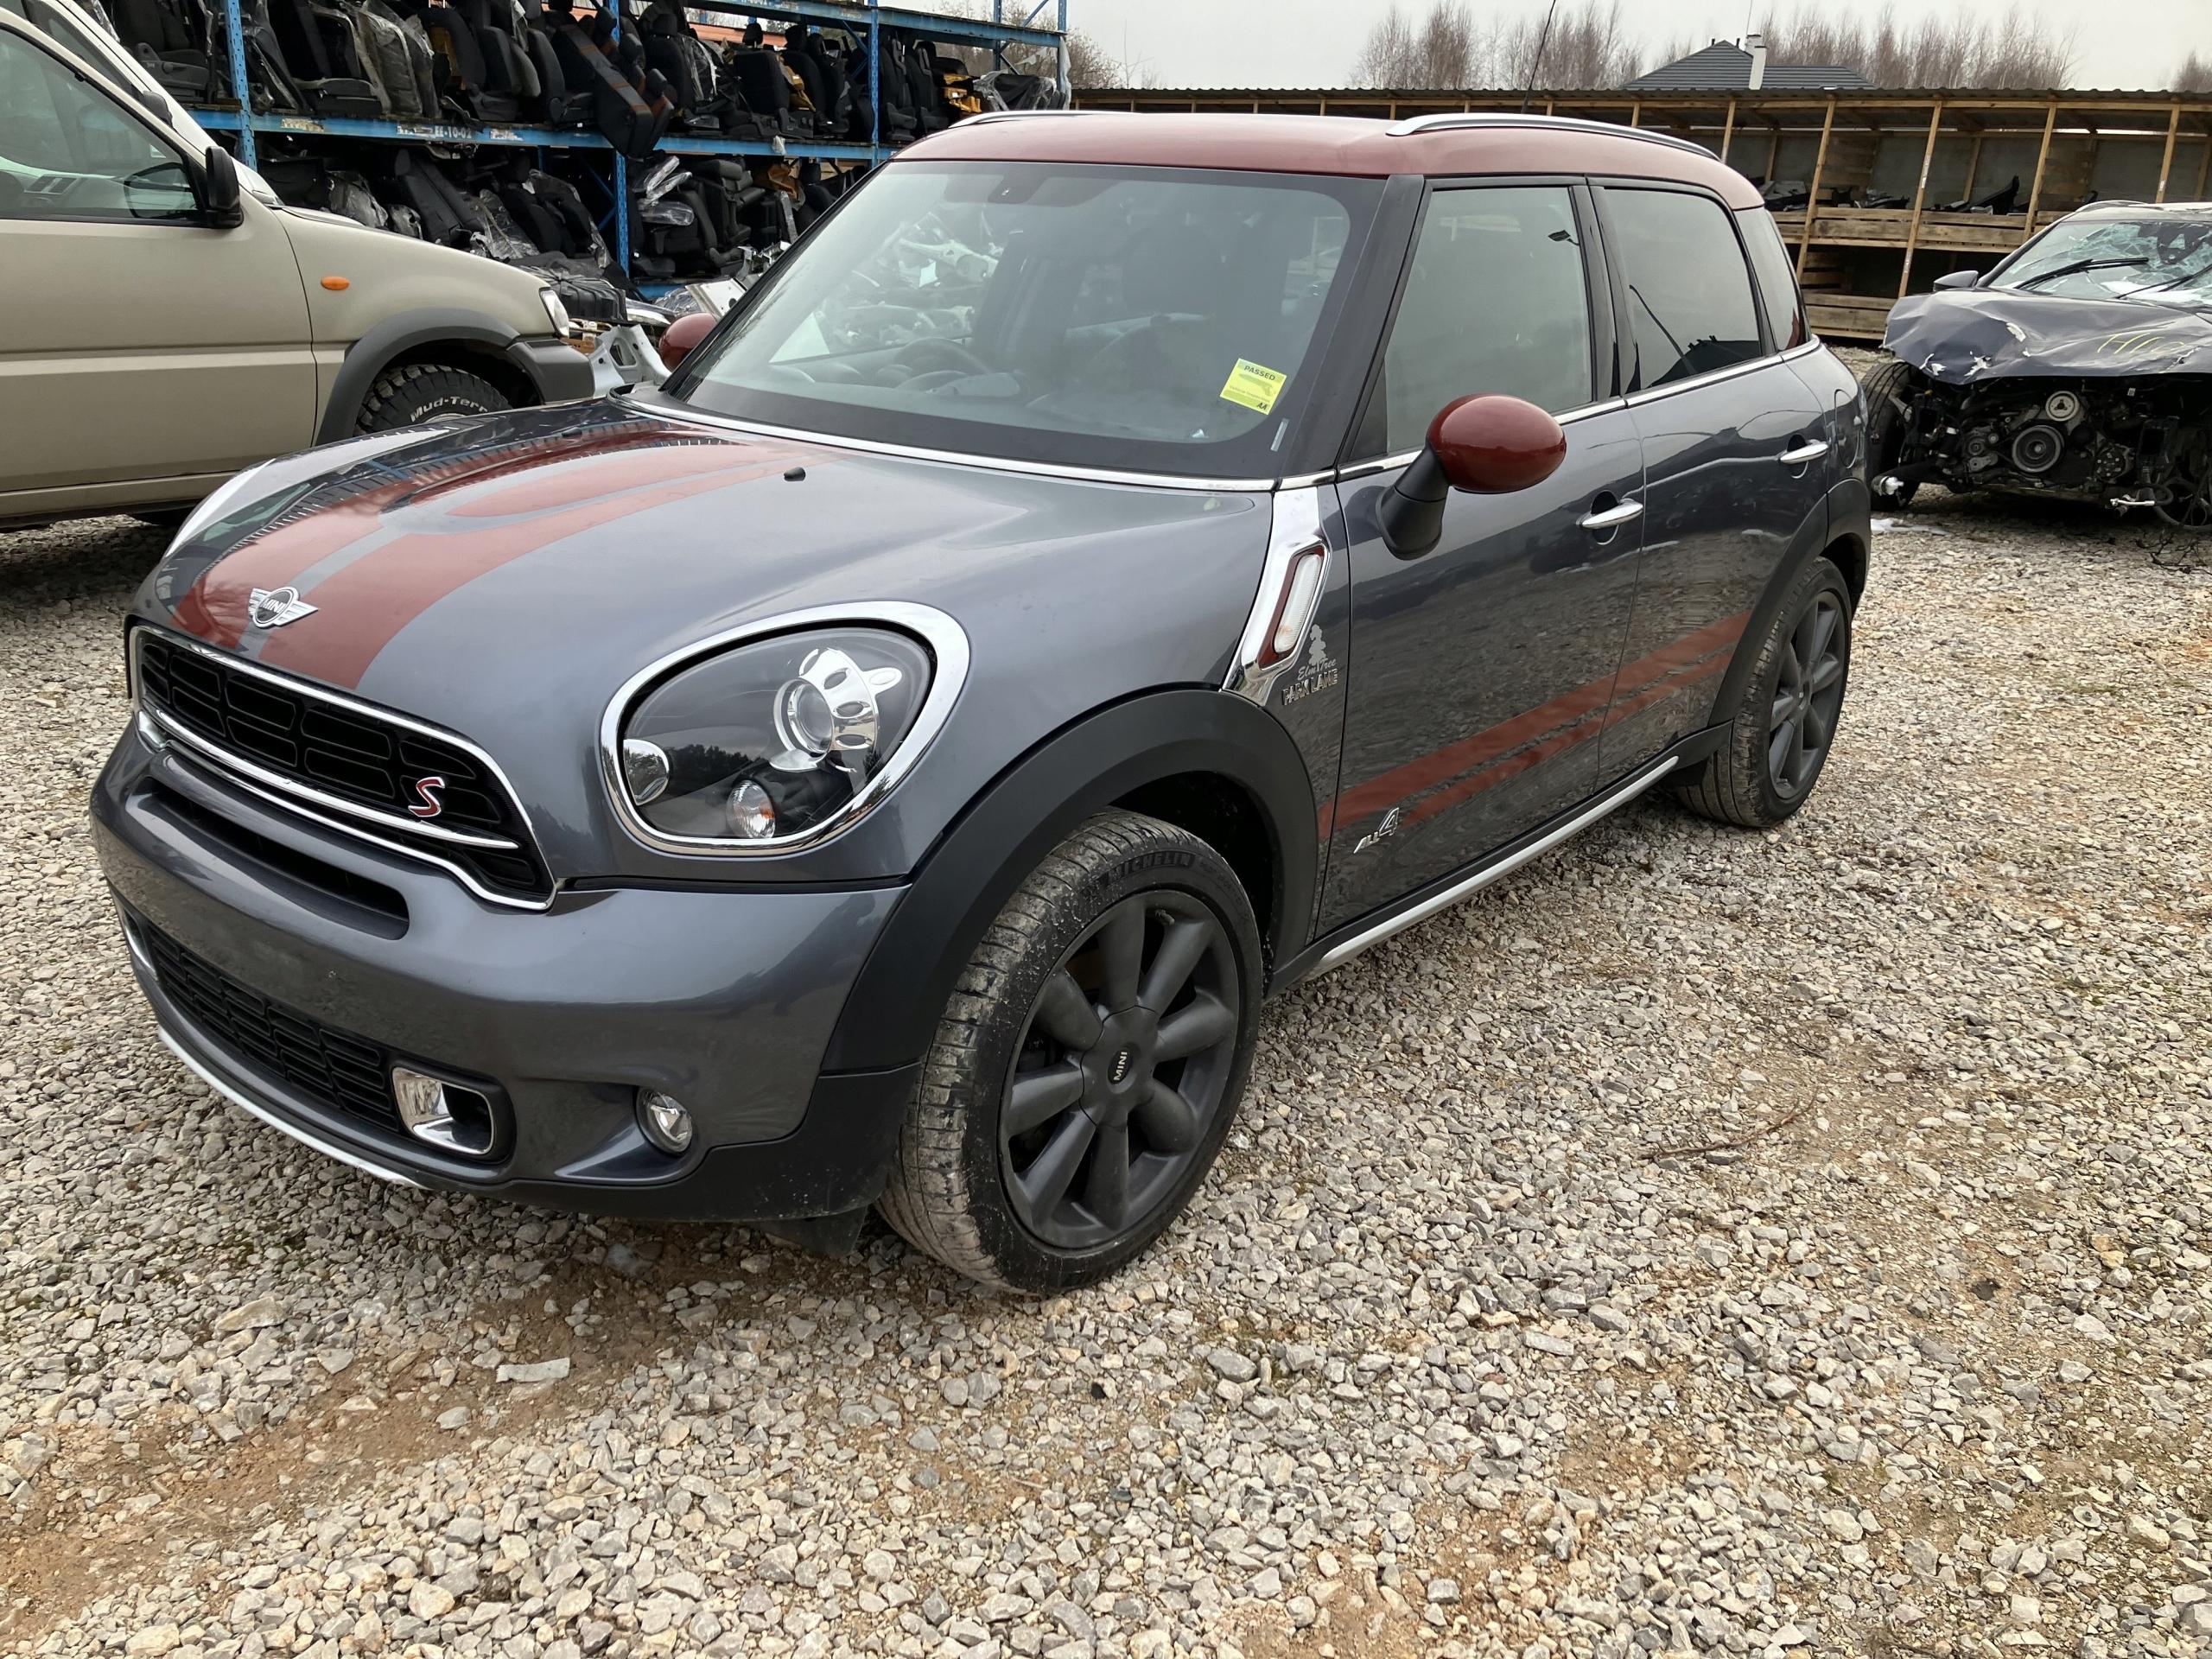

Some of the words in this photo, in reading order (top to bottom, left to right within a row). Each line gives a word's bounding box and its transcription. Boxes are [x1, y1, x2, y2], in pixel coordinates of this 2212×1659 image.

[1243, 365, 1275, 381] PASSED
[1256, 402, 1268, 410] AA
[1282, 678, 1310, 705] PARK
[1311, 668, 1338, 693] LANE
[408, 776, 446, 817] S
[1113, 1051, 1128, 1081] MINI
